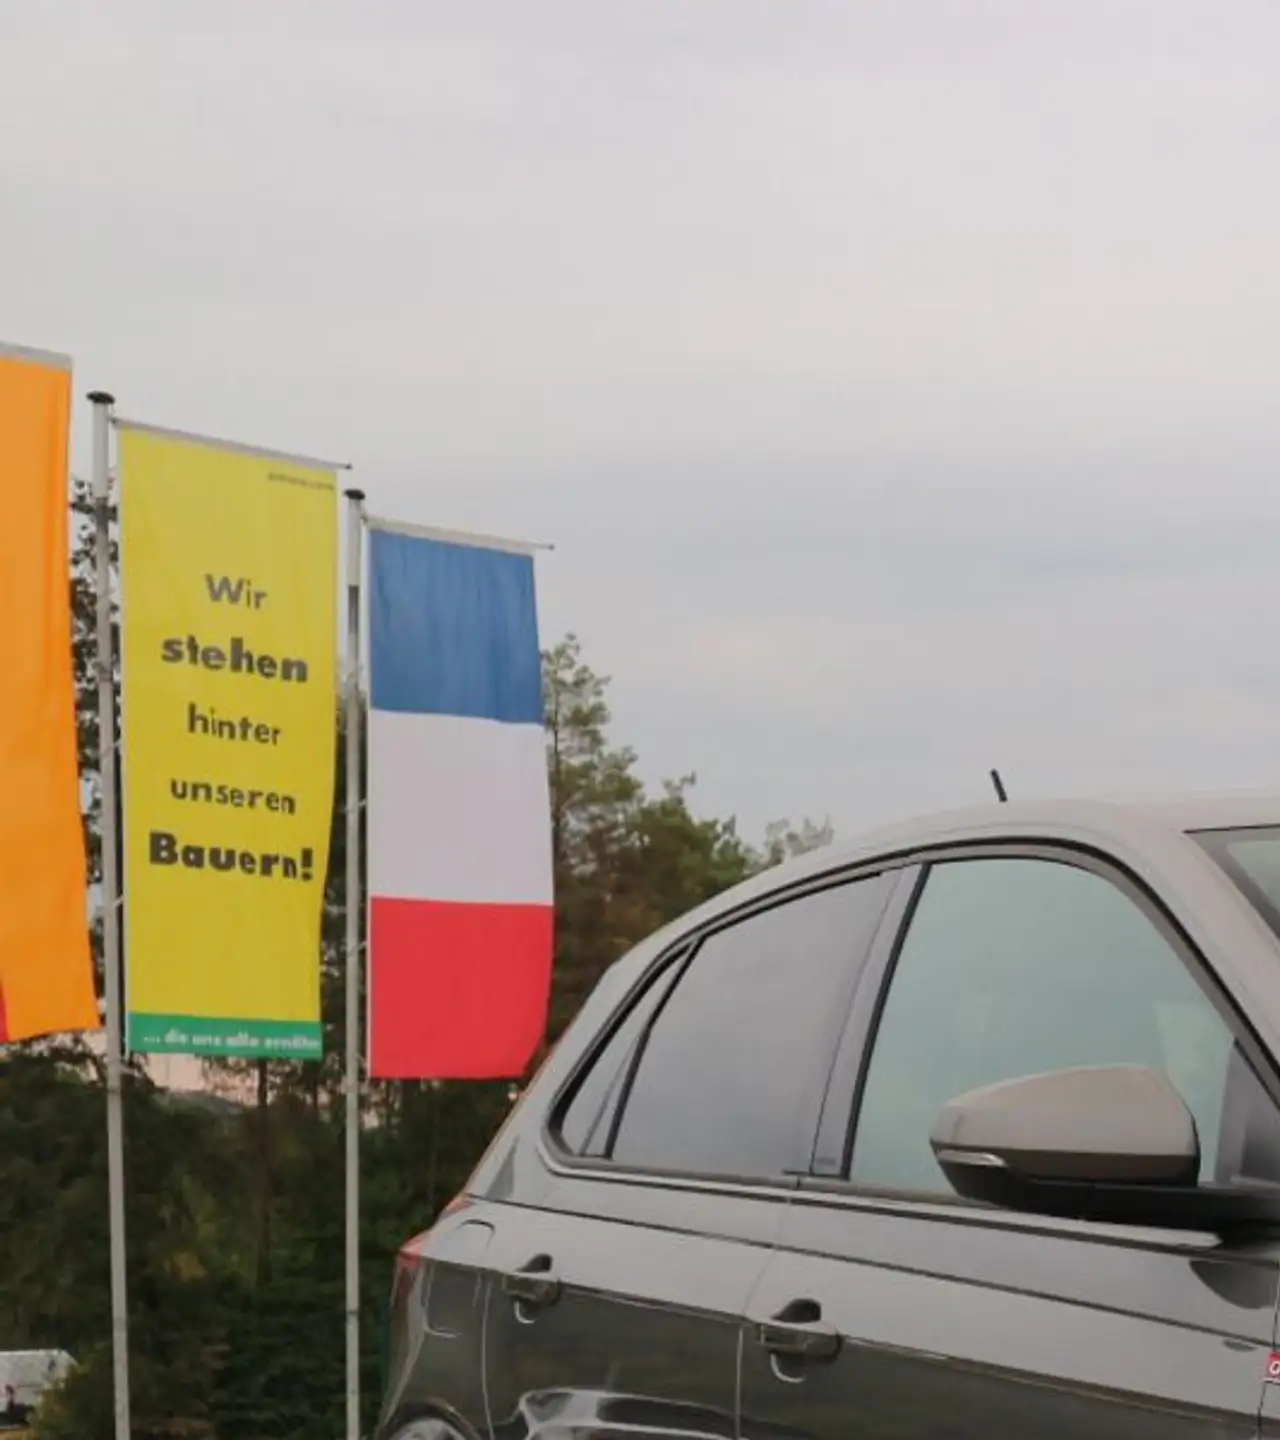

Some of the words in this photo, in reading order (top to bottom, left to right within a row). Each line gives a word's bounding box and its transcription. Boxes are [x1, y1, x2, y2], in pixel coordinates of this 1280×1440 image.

[205, 573, 268, 611] Wir
[161, 637, 309, 684] stehen
[187, 703, 282, 746] hinter
[170, 777, 296, 815] unseren
[149, 831, 314, 881] Bauern!
